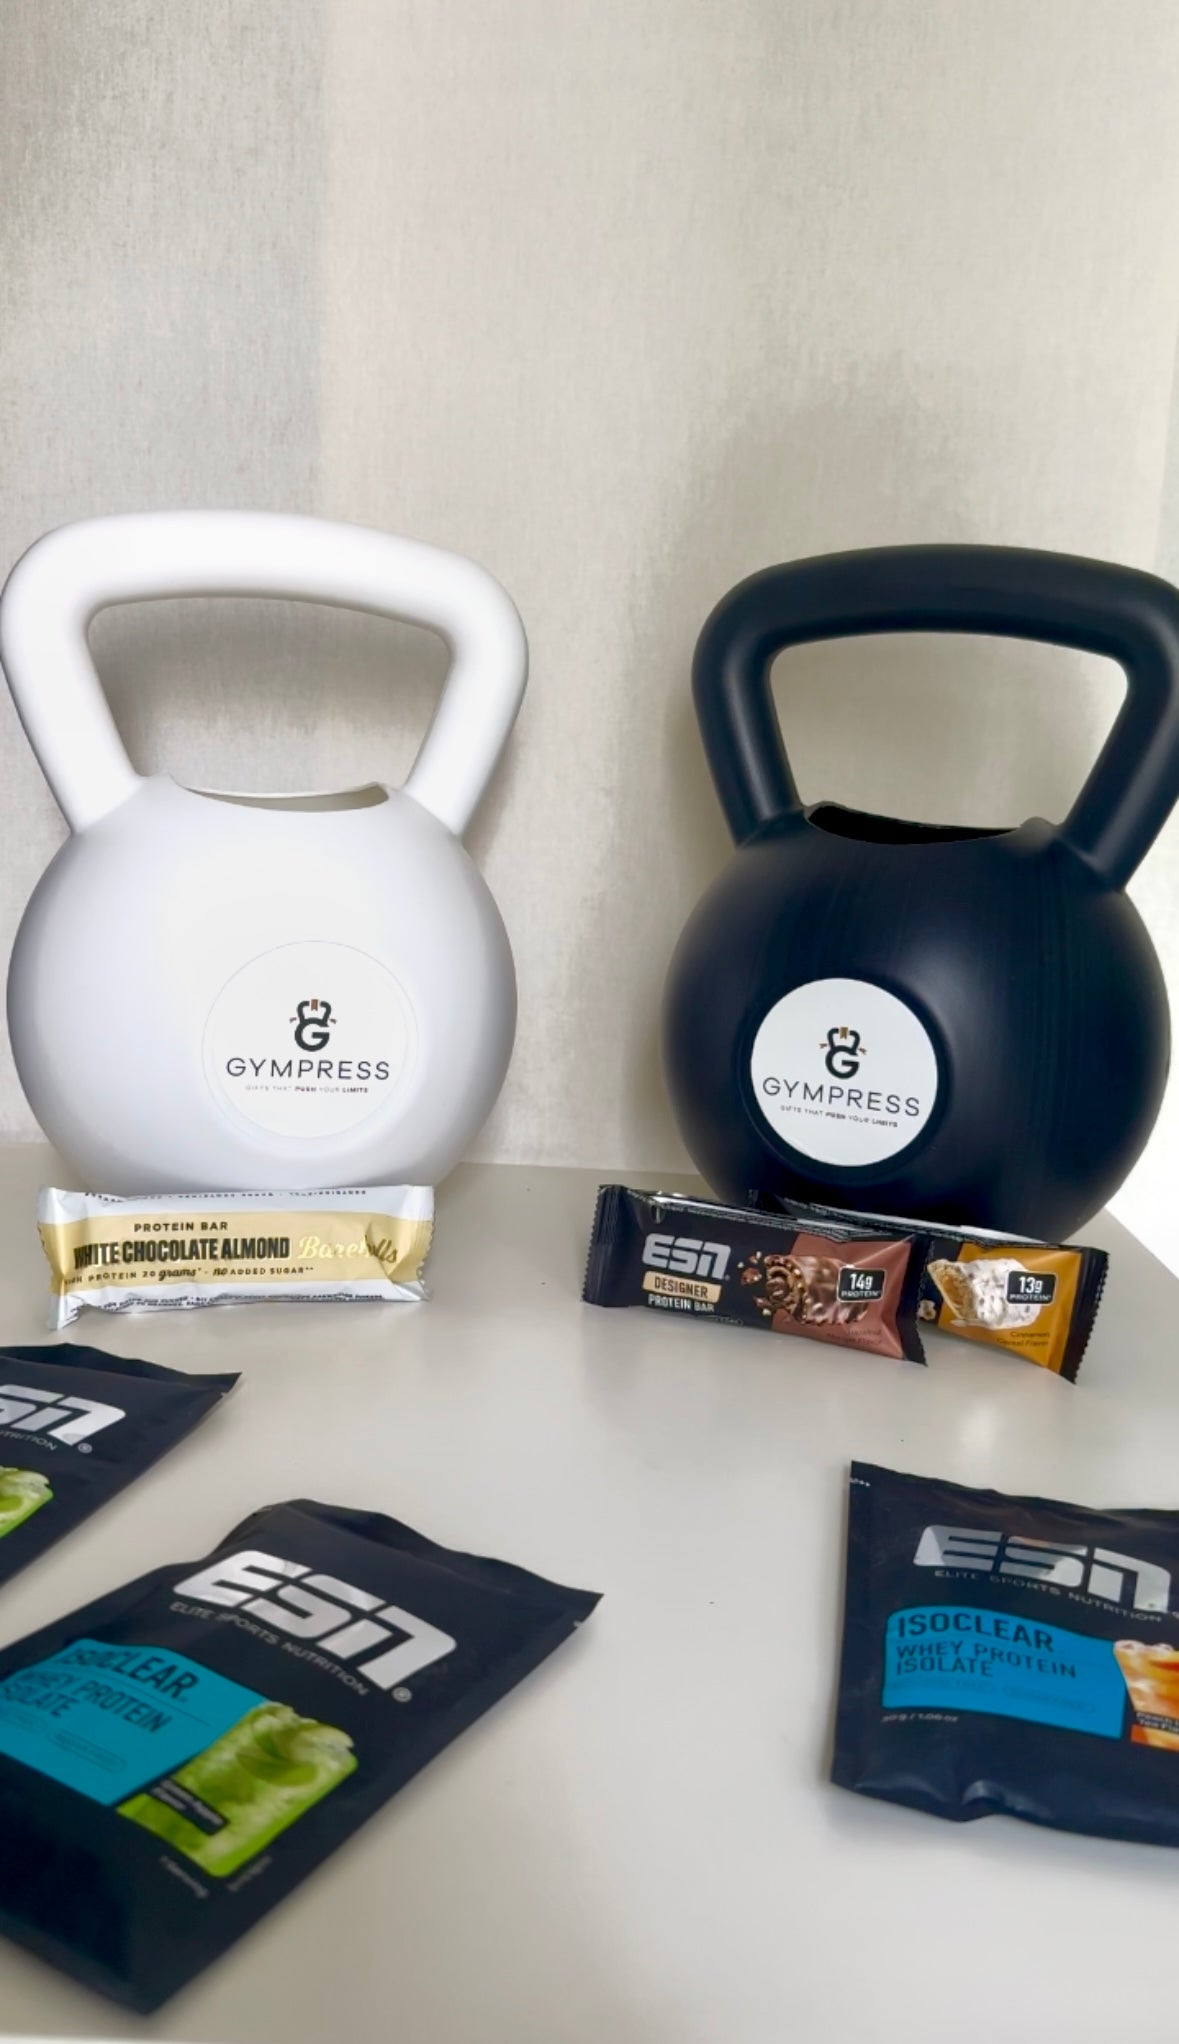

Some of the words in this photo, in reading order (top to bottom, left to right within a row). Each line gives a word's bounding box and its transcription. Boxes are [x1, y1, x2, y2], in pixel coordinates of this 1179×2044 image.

[226, 1057, 390, 1080] GYMPRESS
[762, 1077, 920, 1117] GYMPRESS
[134, 1221, 194, 1233] PROTEIN
[201, 1221, 228, 1231] BAR
[73, 1241, 120, 1270] WHITE
[122, 1238, 218, 1264] CHOCOLATE
[220, 1237, 290, 1260] ALMOND
[88, 1271, 137, 1282] PROTEIN
[212, 1267, 227, 1276] no
[230, 1267, 266, 1275] ADDED
[849, 1273, 873, 1290] 14g
[1018, 1276, 1043, 1294] 13g
[654, 1276, 708, 1298] DESIGNER
[648, 1294, 692, 1311] PROTEIN
[694, 1301, 714, 1313] BAR
[0, 1384, 126, 1446] SN
[0, 1430, 58, 1451] TRITION
[934, 1569, 979, 1581] ELITE
[989, 1574, 1061, 1595] SPORTS
[1068, 1591, 1162, 1623] NUTRITION
[898, 1612, 1054, 1652] ISOCLEAR
[169, 1601, 212, 1621] ELITE
[214, 1611, 280, 1645] SPORTS
[281, 1641, 370, 1697] NUTRITION
[896, 1640, 964, 1659] WHEY
[974, 1642, 1077, 1679] PROTEIN
[896, 1656, 993, 1678] ISOLATE
[70, 1679, 174, 1733] PROTEIN
